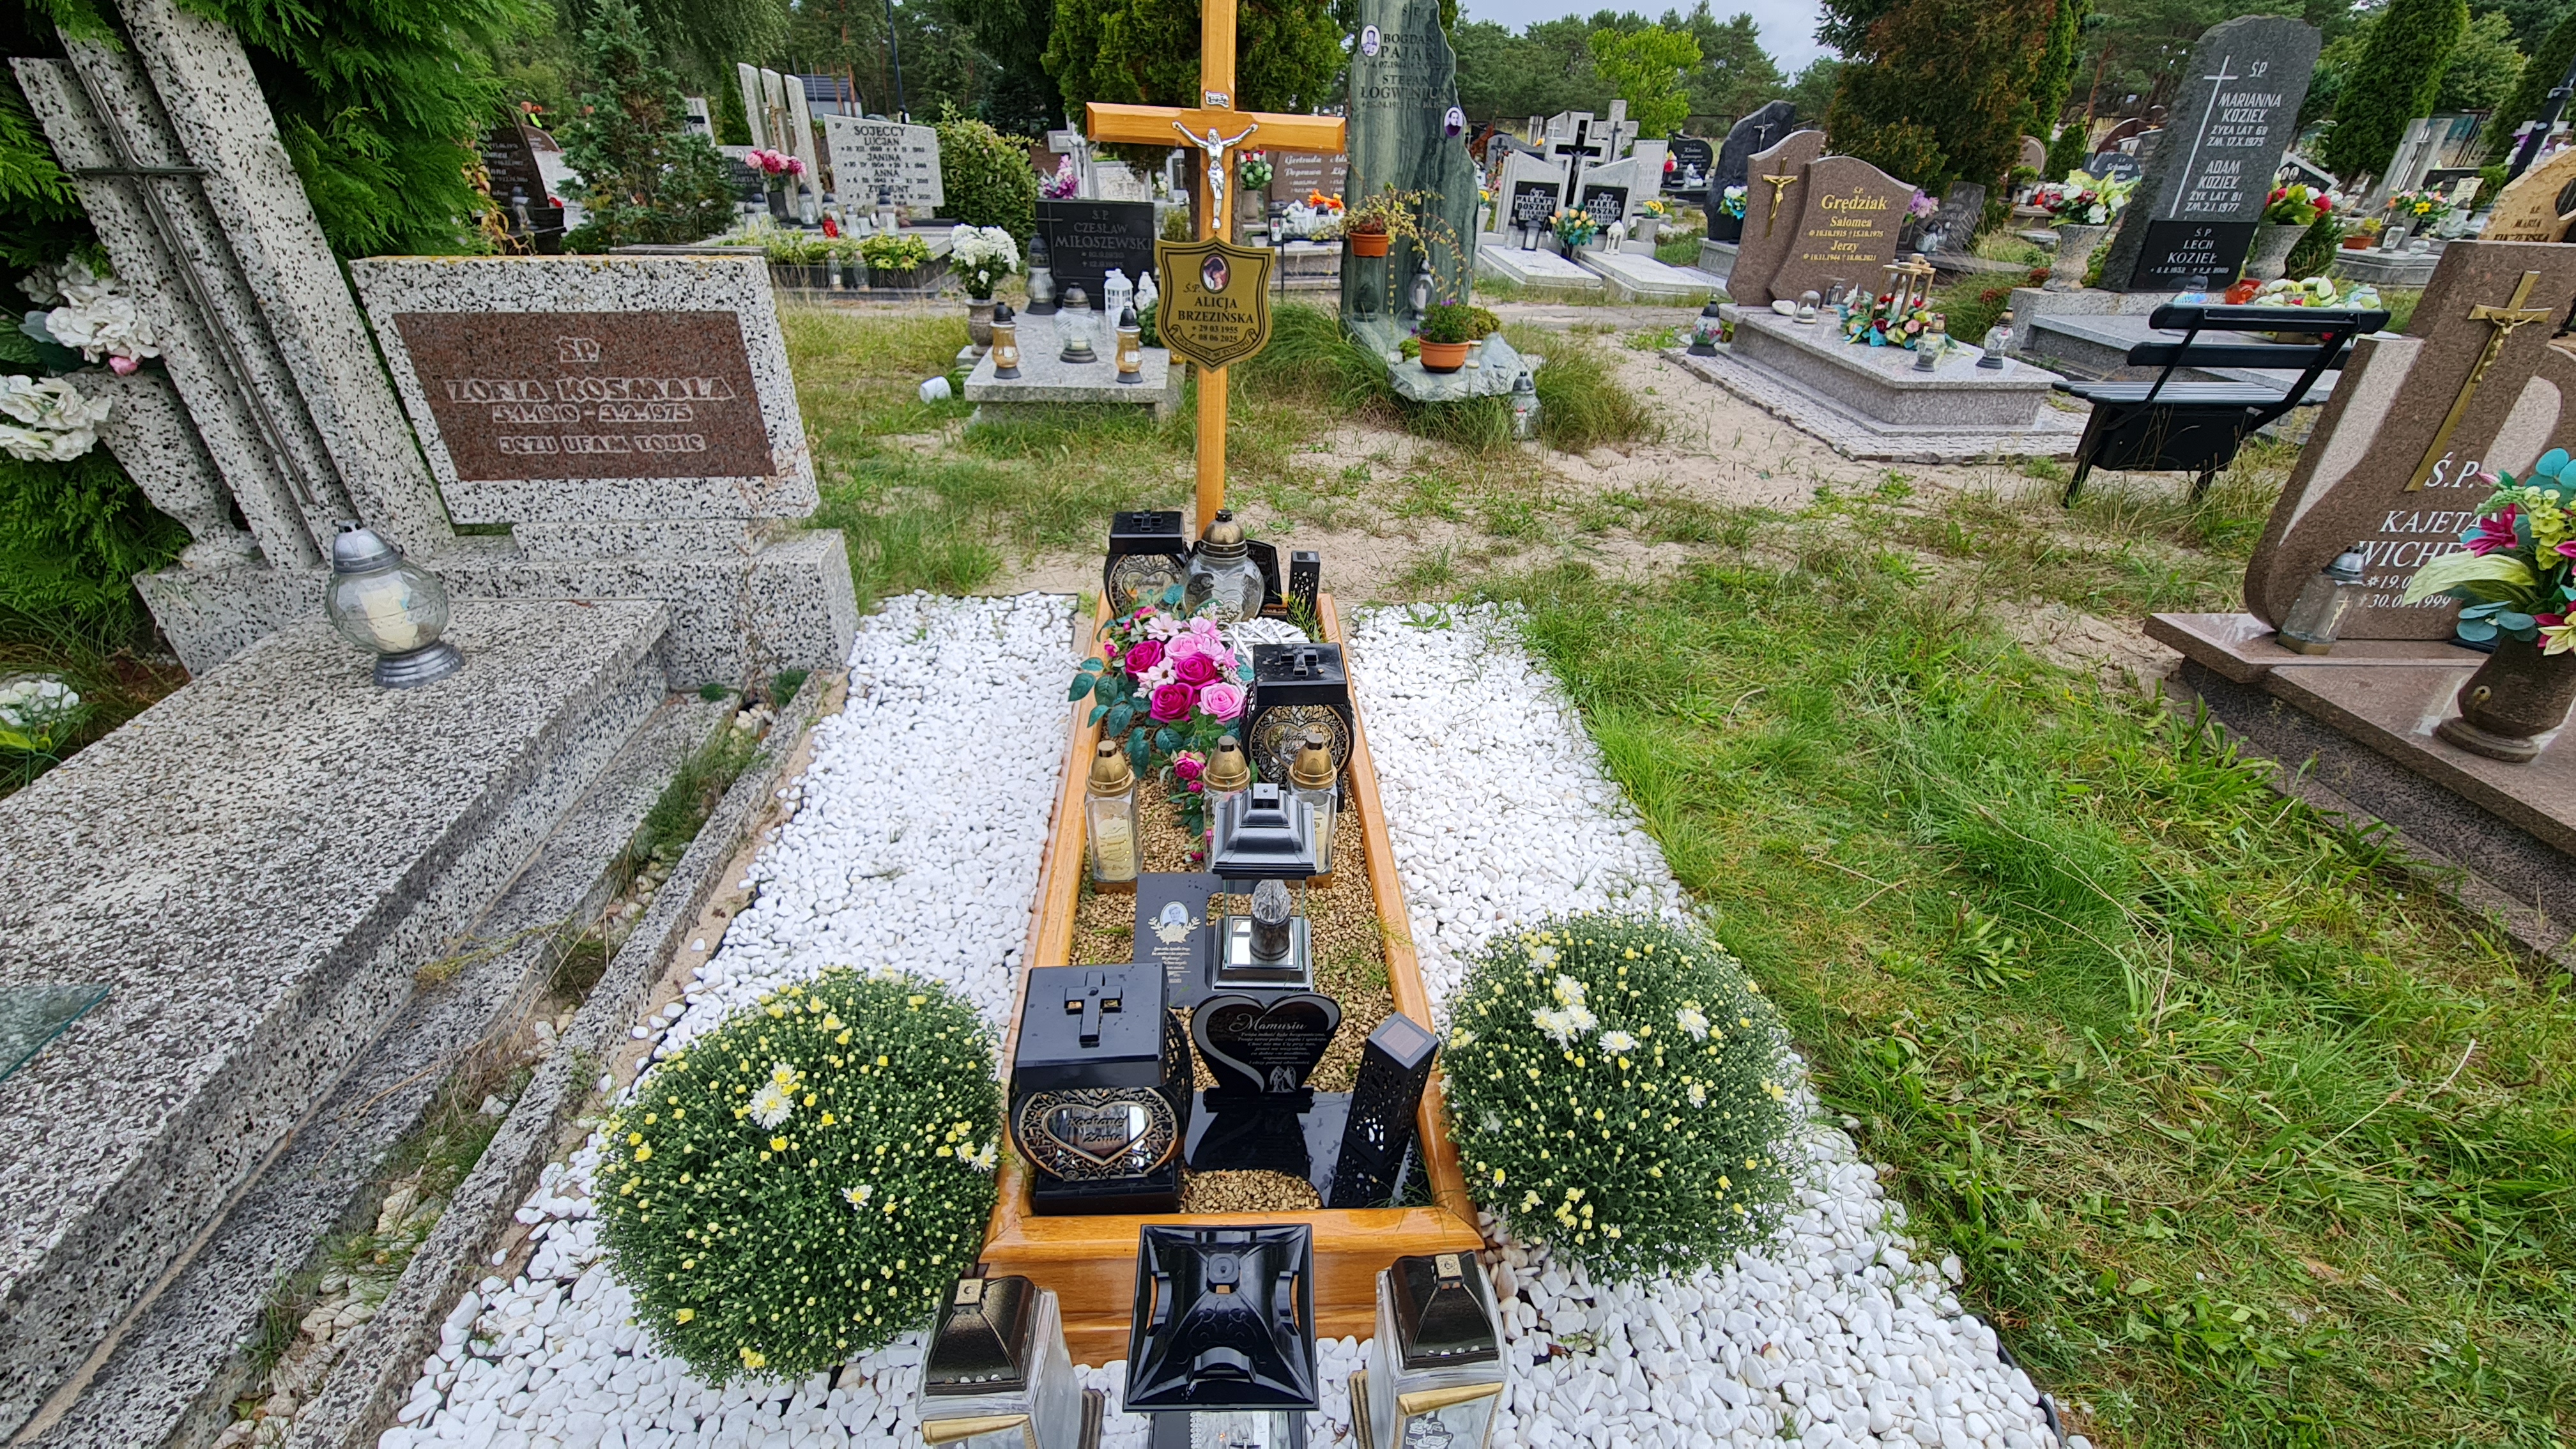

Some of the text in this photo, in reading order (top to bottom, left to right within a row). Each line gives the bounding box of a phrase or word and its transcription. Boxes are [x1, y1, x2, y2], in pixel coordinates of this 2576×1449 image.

[1383, 33, 1433, 45] BOGDAN
[2218, 93, 2281, 107] MARIANNA
[2221, 108, 2268, 123] KOZIEŁ
[854, 126, 906, 137] SOJECCY
[2235, 125, 2254, 135] LAT
[864, 137, 900, 146] LUCJAN
[866, 153, 901, 162] JANINA
[873, 169, 900, 178] ANNA
[2204, 160, 2241, 174] ADAM
[2196, 176, 2242, 189] KOZIEŁ
[868, 185, 910, 194] ZYMUNT
[2209, 192, 2228, 201] LAT
[2230, 192, 2244, 201] 81
[1821, 194, 1888, 213] Grędziak
[1829, 215, 1873, 227] Salomea
[1073, 222, 1128, 234] CZESŁAW
[1055, 235, 1152, 250] MIŁOSZEWSKI
[1830, 240, 1860, 254] Jerzy
[2183, 240, 2215, 249] LECH
[2167, 252, 2218, 264] KOZIEŁ
[1194, 296, 1238, 310] ALICJA
[1178, 309, 1254, 324] BRZEZIŃSKA
[445, 376, 737, 404] ZOFIA KOSMALA
[560, 435, 632, 454] UFAM
[2423, 451, 2480, 489] Ś.P.
[2359, 540, 2465, 568] WICHE
[2368, 594, 2452, 609] 30.0.1999
[1229, 1013, 1307, 1032] Mamusiu
[1084, 1132, 1123, 1142] Żonie
